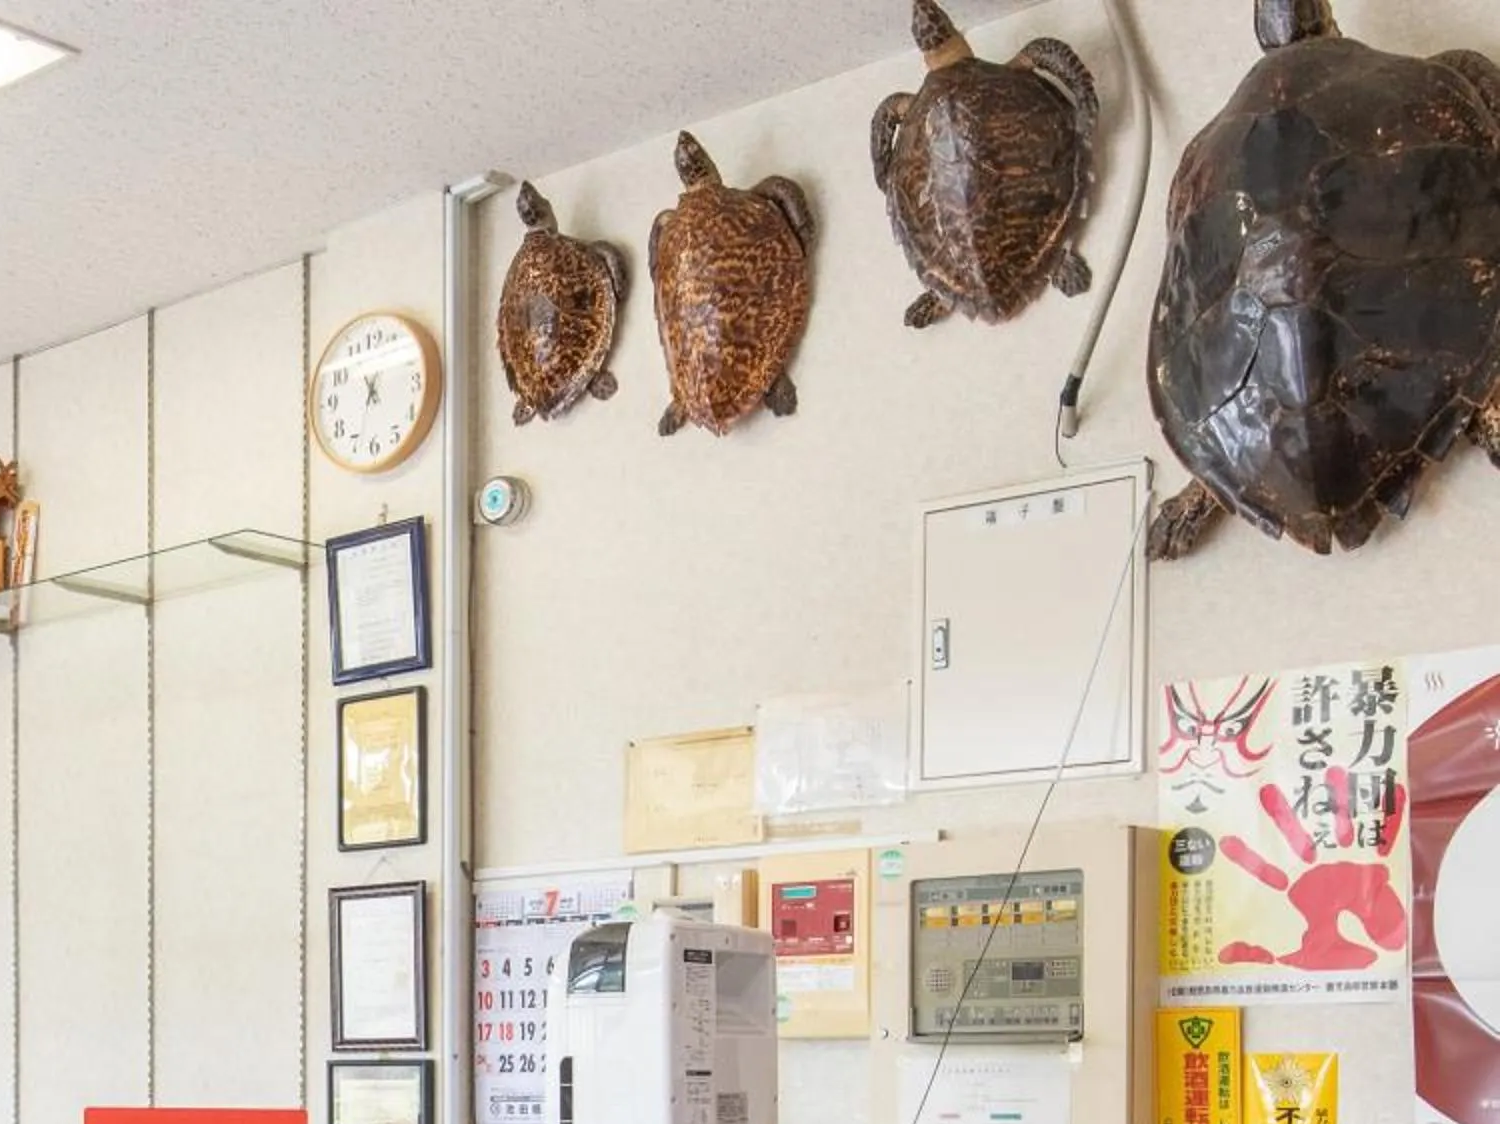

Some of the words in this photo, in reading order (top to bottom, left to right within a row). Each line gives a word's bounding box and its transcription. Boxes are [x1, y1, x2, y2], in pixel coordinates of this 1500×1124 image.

[332, 367, 349, 387] 10
[327, 394, 339, 412] 9
[334, 420, 346, 439] 8
[389, 424, 401, 445] 5
[349, 433, 360, 454] 7
[369, 434, 381, 457] 6
[1347, 665, 1399, 849] 暴力団は
[546, 890, 560, 917] 7
[482, 959, 491, 978] 3
[502, 956, 511, 977] 4
[524, 957, 533, 977] 5
[478, 991, 493, 1010] 10
[500, 990, 514, 1009] 11
[520, 989, 536, 1009] 12
[478, 1023, 493, 1042] 17
[499, 1021, 514, 1041] 18
[519, 1021, 536, 1041] 19
[499, 1054, 514, 1073] 25
[519, 1054, 536, 1073] 26
